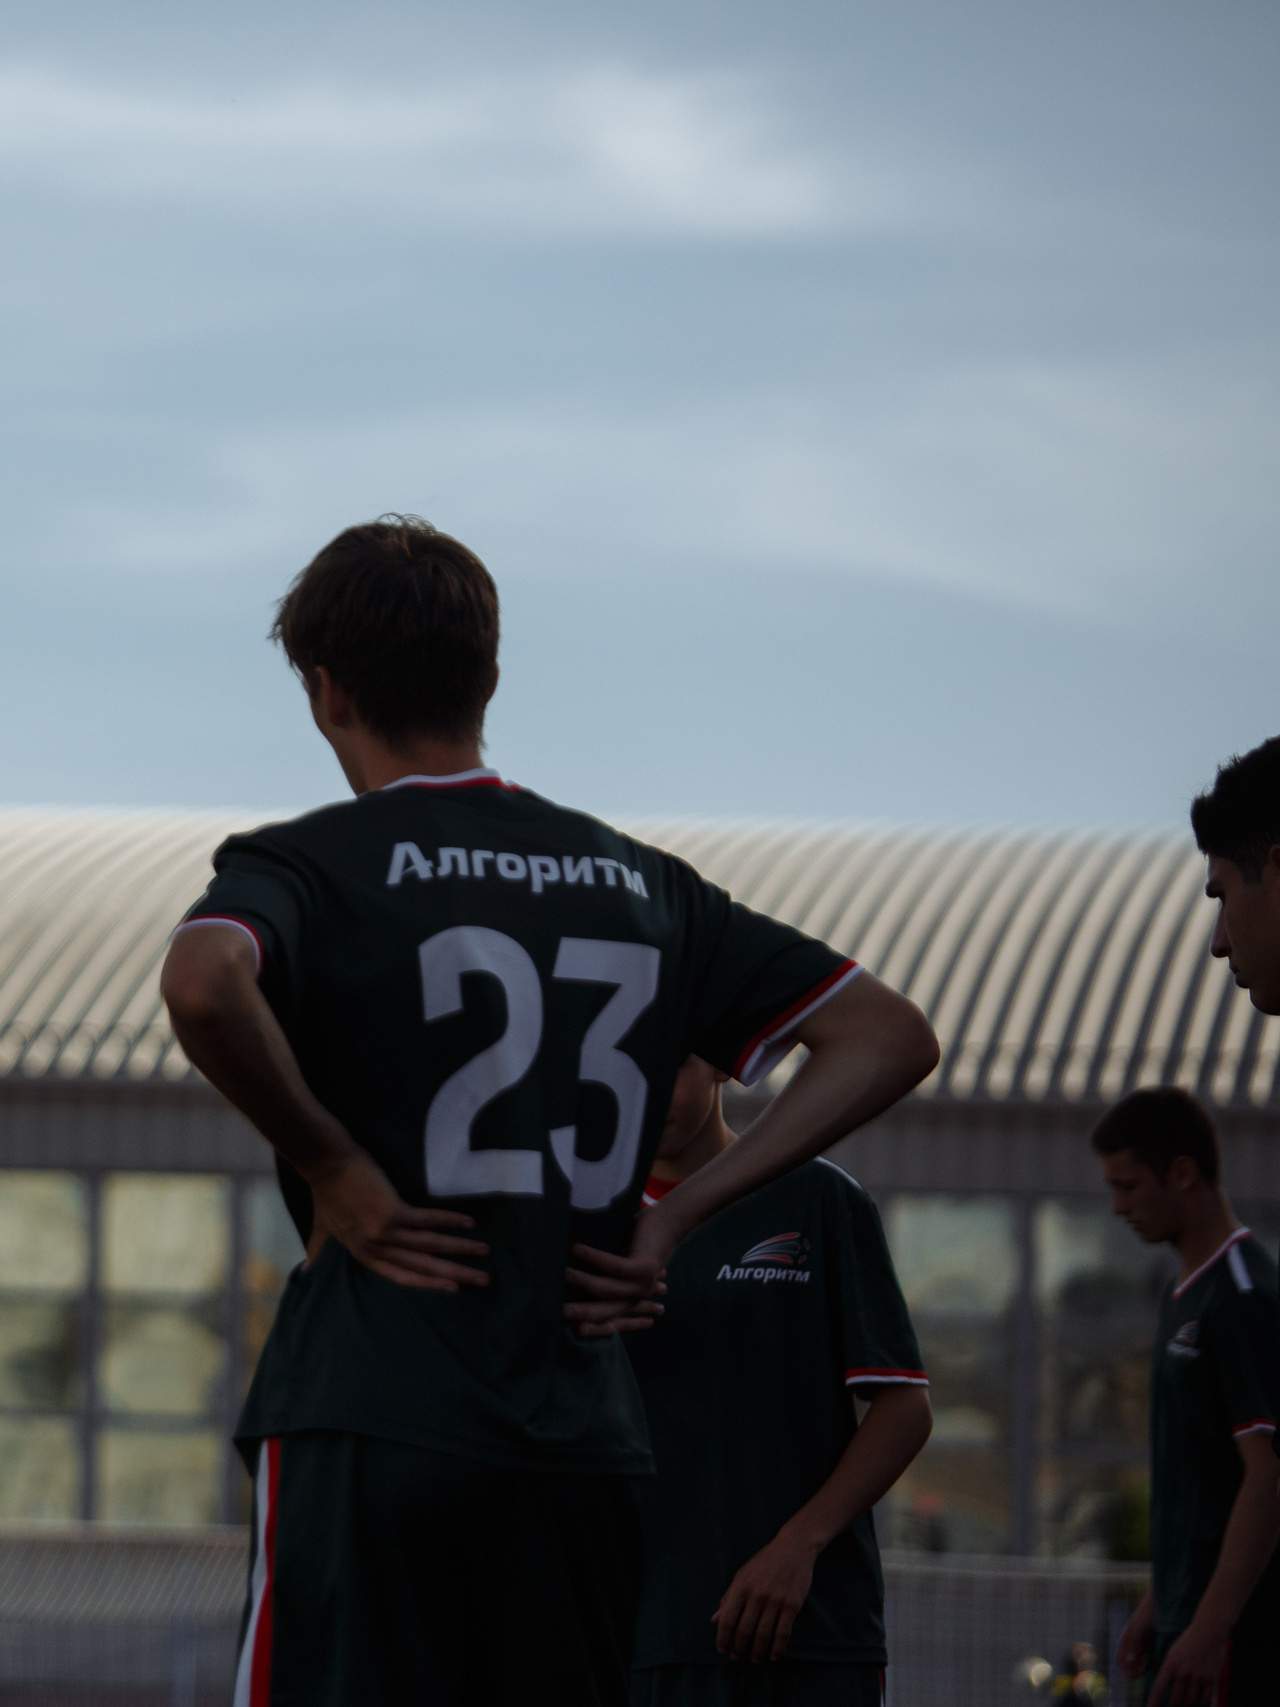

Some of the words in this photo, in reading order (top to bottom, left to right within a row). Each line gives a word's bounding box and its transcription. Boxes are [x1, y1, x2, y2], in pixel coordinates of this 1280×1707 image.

[386, 840, 650, 899] Алгоритм
[418, 925, 662, 1212] 23
[717, 1263, 811, 1284] Алгоритм
